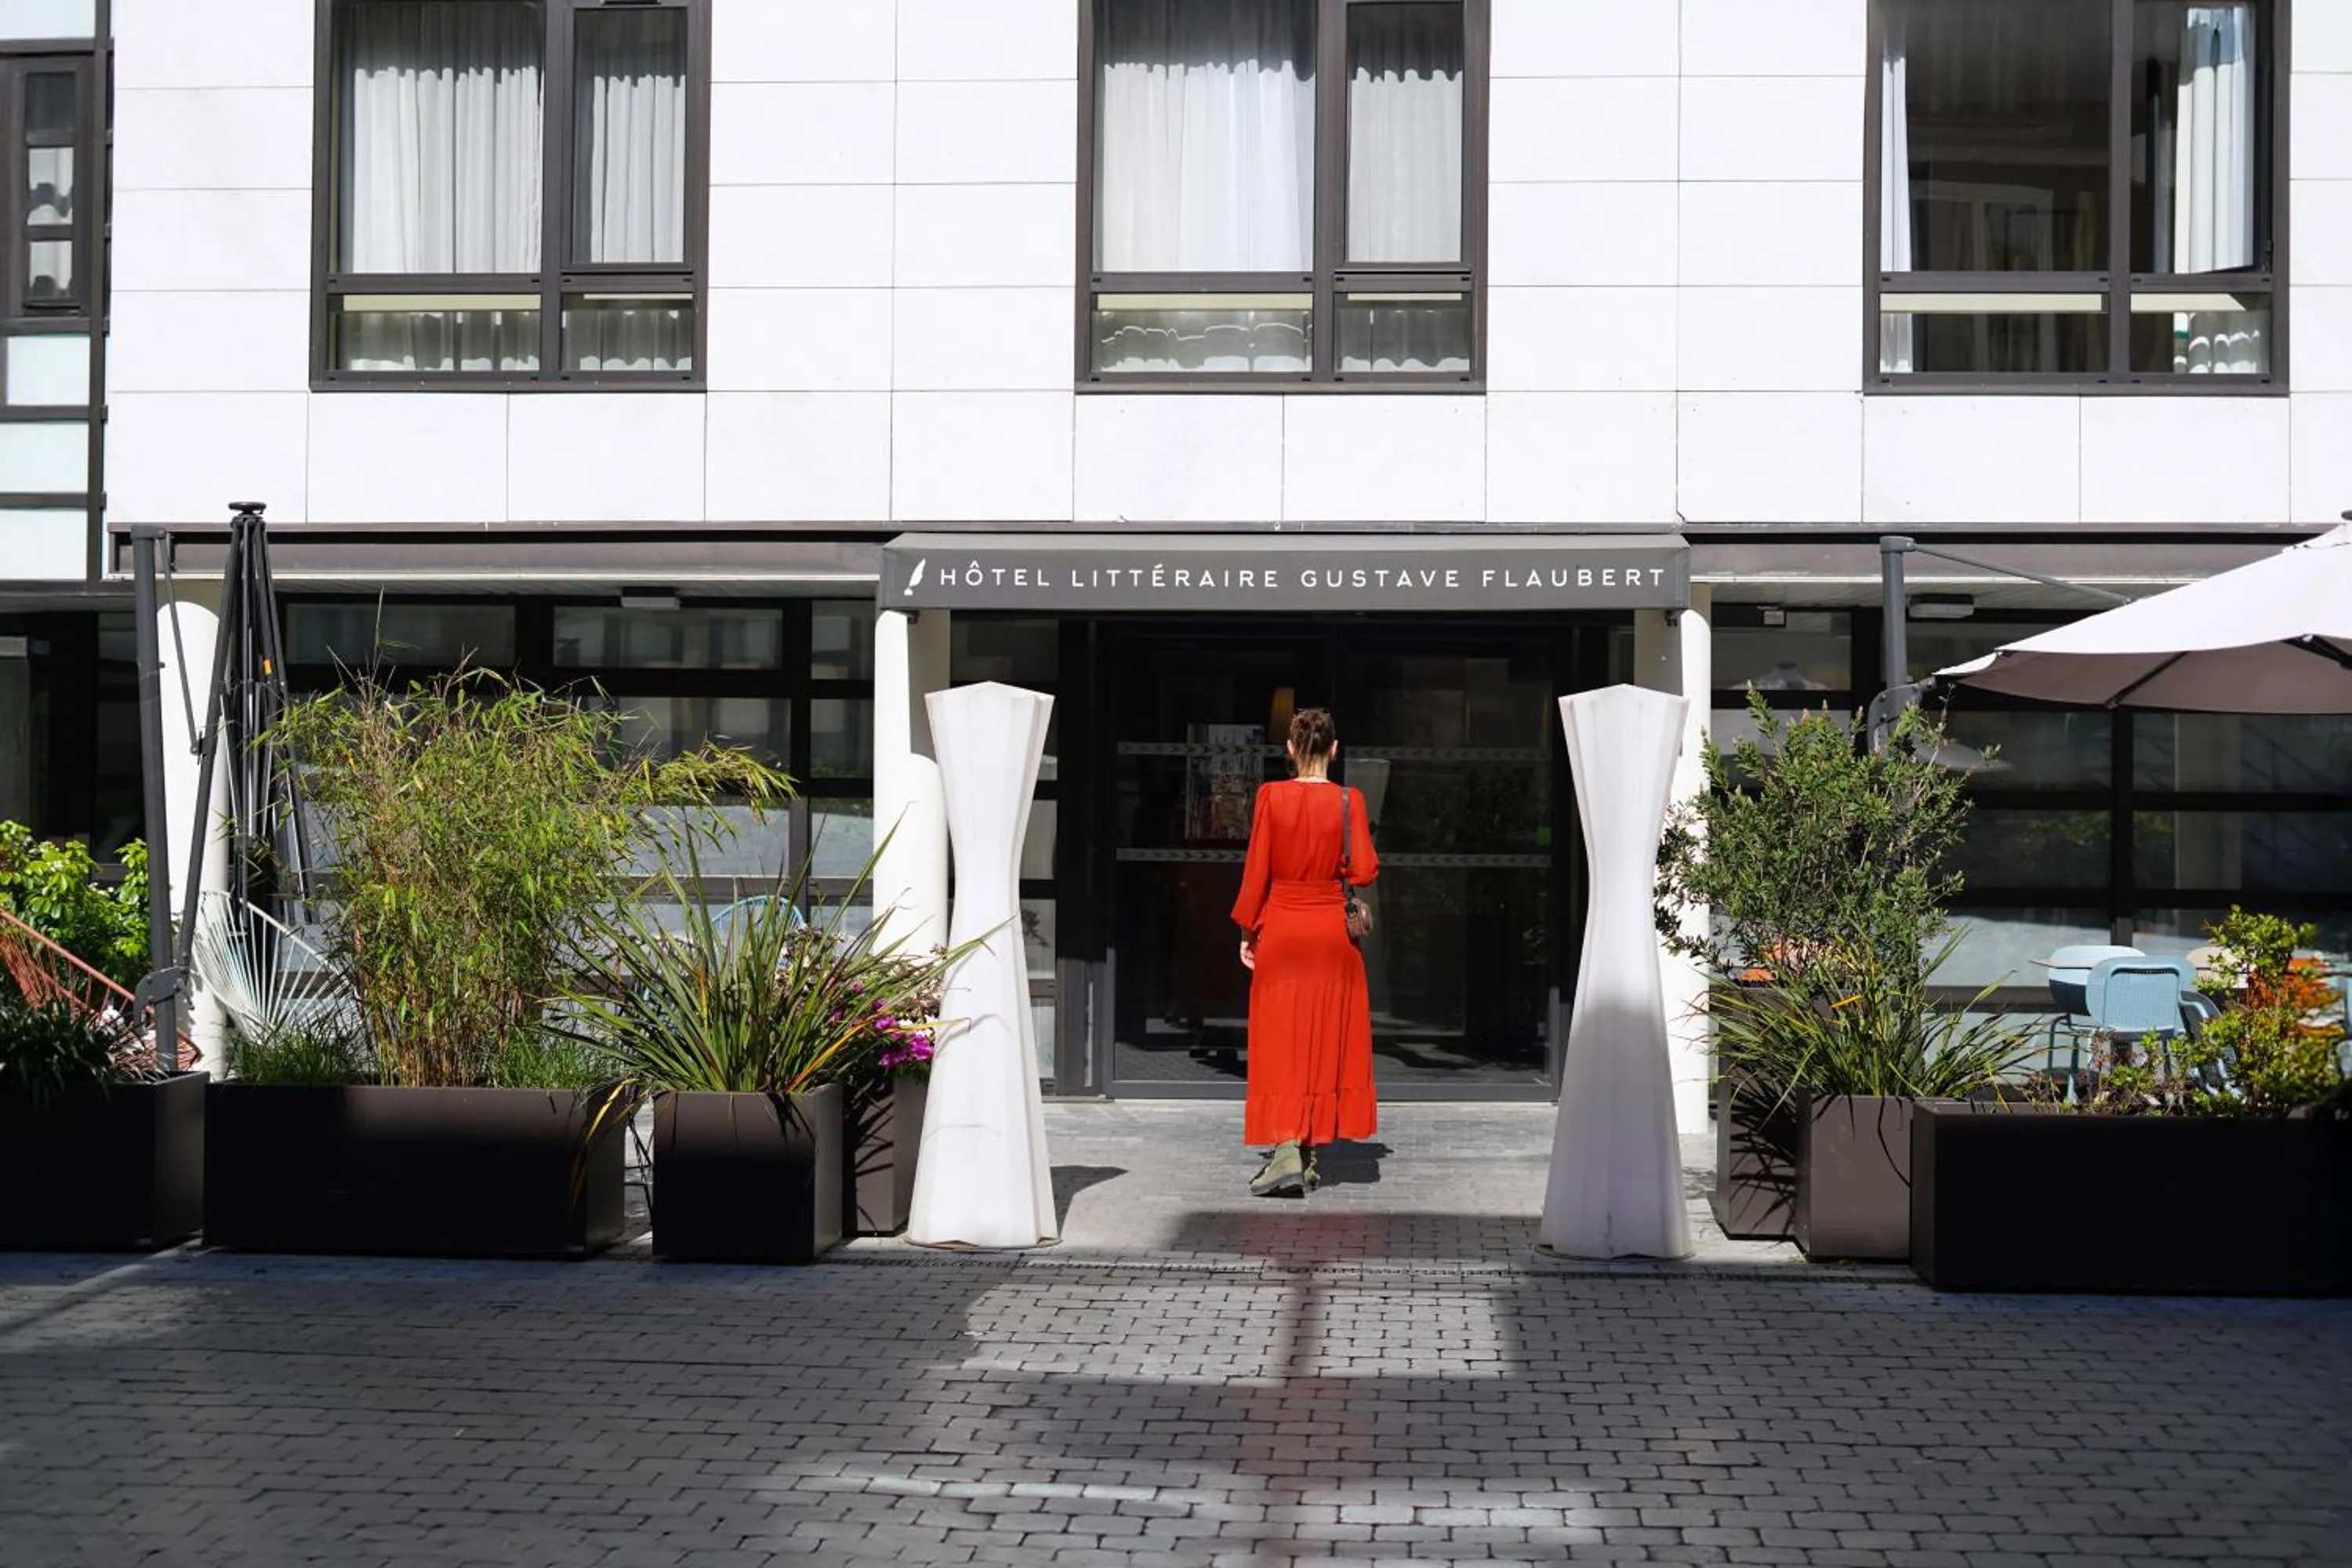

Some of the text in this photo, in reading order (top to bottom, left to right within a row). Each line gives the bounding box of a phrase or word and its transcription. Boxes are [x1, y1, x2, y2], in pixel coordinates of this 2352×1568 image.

[940, 560, 1664, 588] HÔTEL LITTÉRAIRE GUSTAVE FLAUBERT
